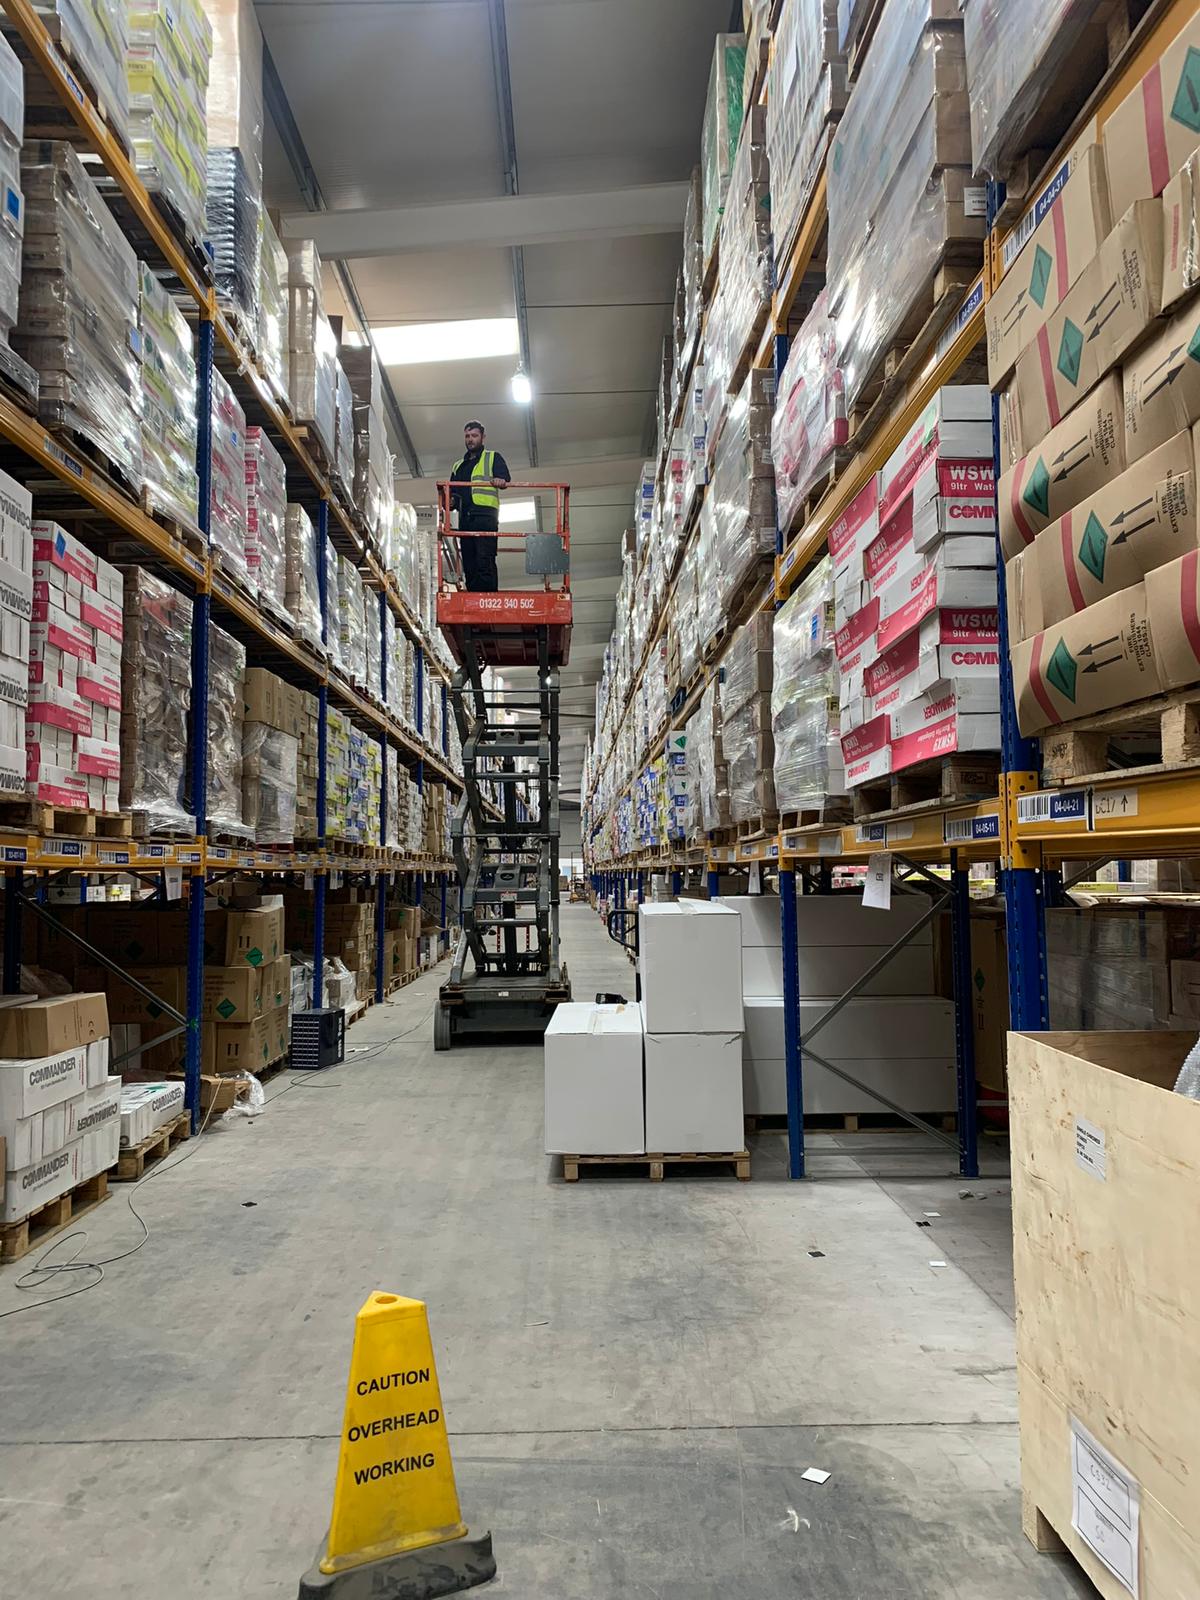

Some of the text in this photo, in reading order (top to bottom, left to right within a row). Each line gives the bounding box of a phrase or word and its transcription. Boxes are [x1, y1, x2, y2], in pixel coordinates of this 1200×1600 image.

[1039, 175, 1065, 215] 04-04-31
[479, 598, 535, 609] 01322 340 502
[952, 629, 969, 638] 9ltr
[1054, 799, 1079, 813] 04-04-21
[975, 822, 995, 835] 04-05-11
[29, 1056, 76, 1086] COMMANDER
[151, 1086, 184, 1112] COMMANDER
[77, 1102, 118, 1132] COMMANDER
[22, 1152, 69, 1190] COMMANDER
[356, 1368, 430, 1396] CAUTION
[348, 1409, 440, 1442] OVERHEAD
[354, 1453, 435, 1485] WORKING
